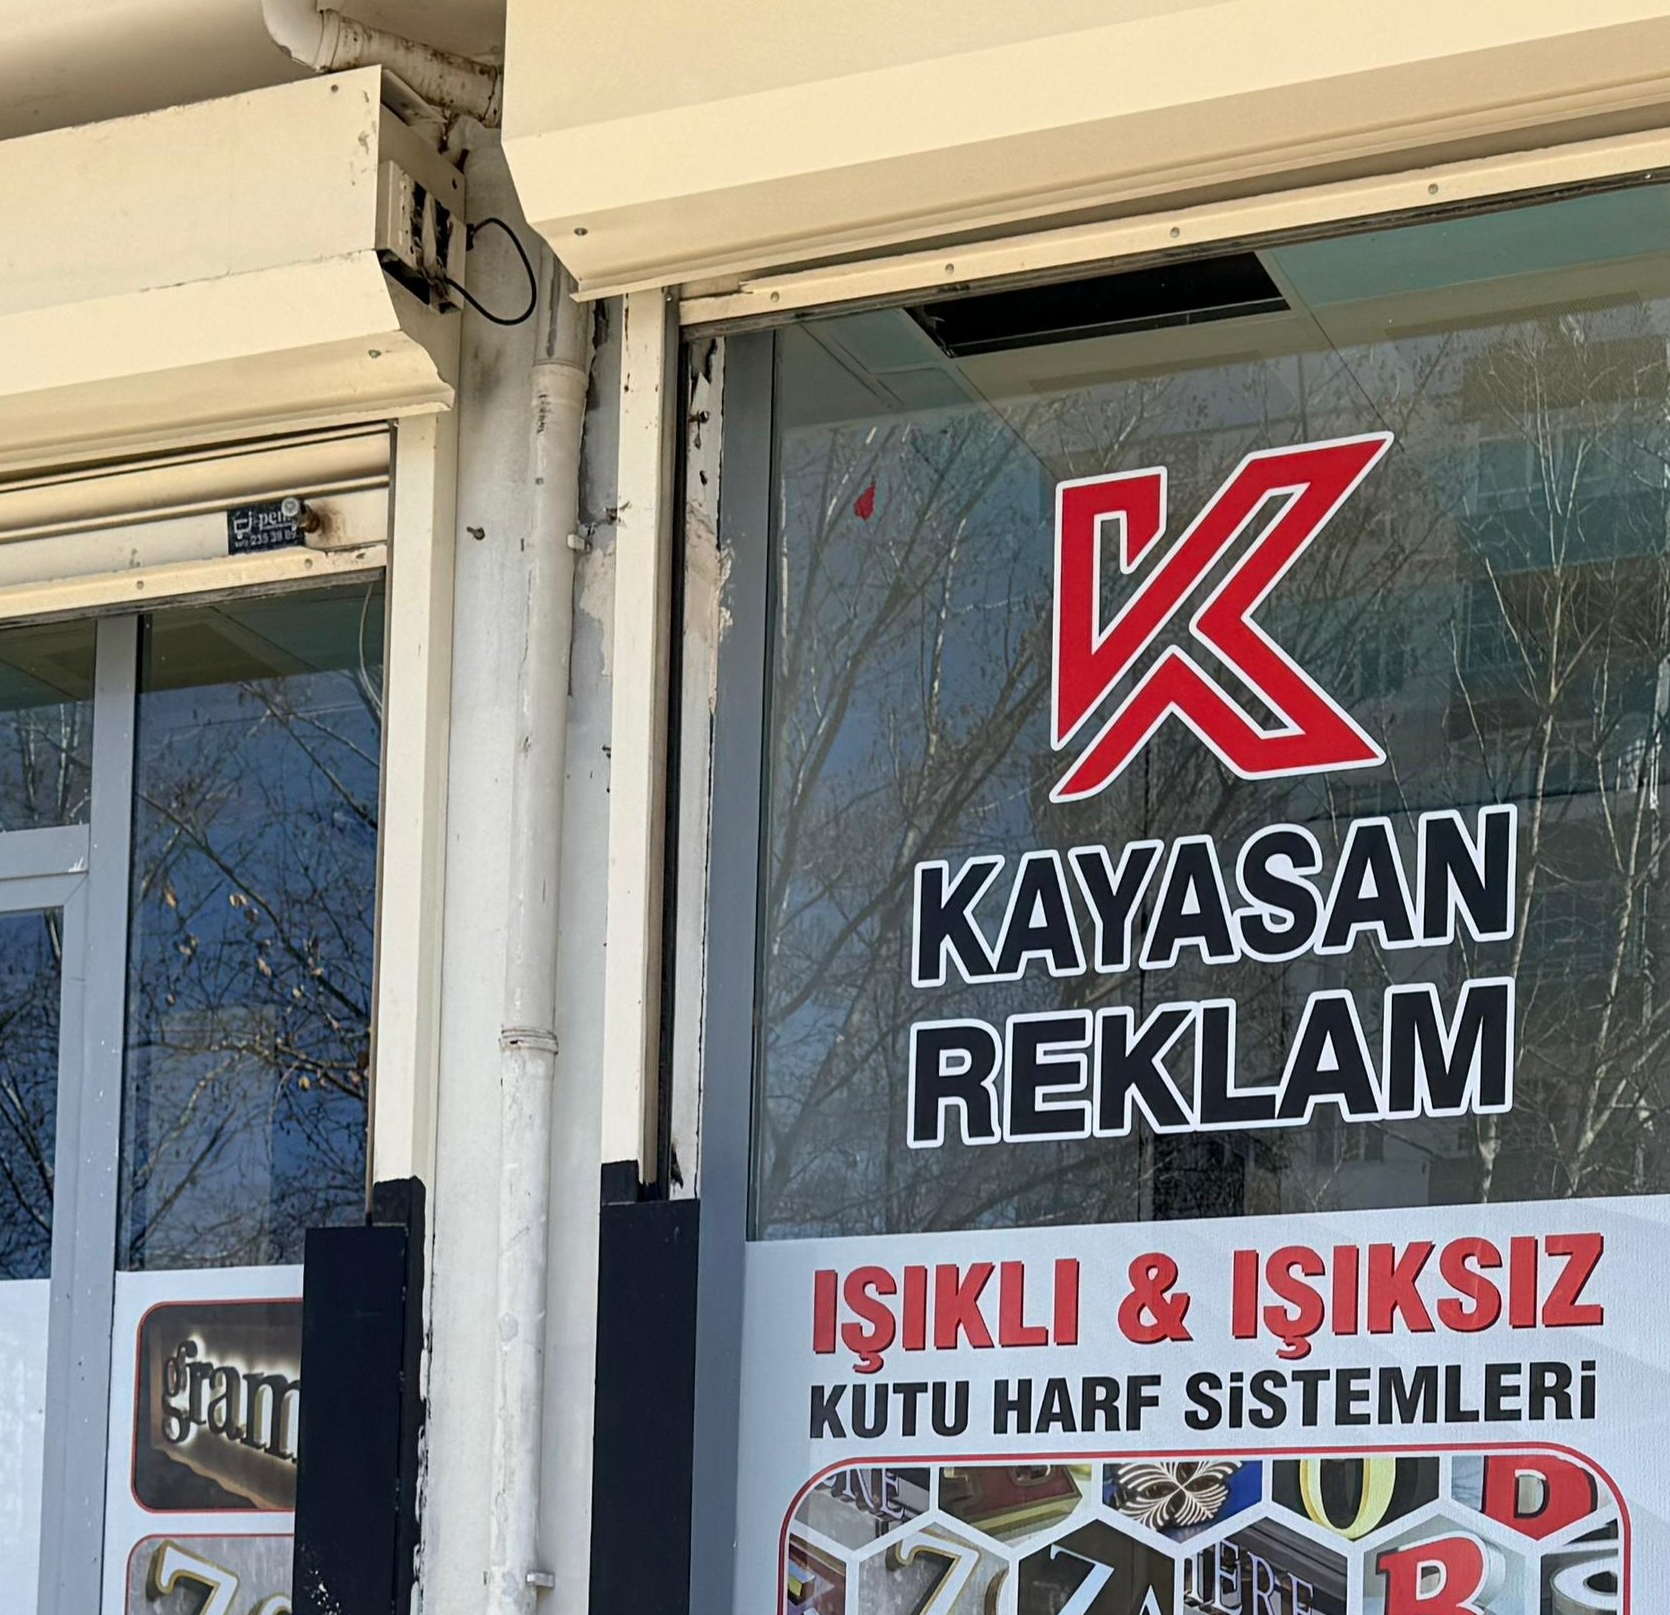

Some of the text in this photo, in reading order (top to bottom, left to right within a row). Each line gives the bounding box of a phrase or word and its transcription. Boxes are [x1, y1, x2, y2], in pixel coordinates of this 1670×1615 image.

[911, 802, 1518, 989] KAYASAN
[907, 976, 1515, 1150] REKLAM
[811, 1231, 1606, 1375] IŞIKLI & IŞIKSIZ
[809, 1380, 970, 1440] KUTU
[993, 1373, 1162, 1434] HARF
